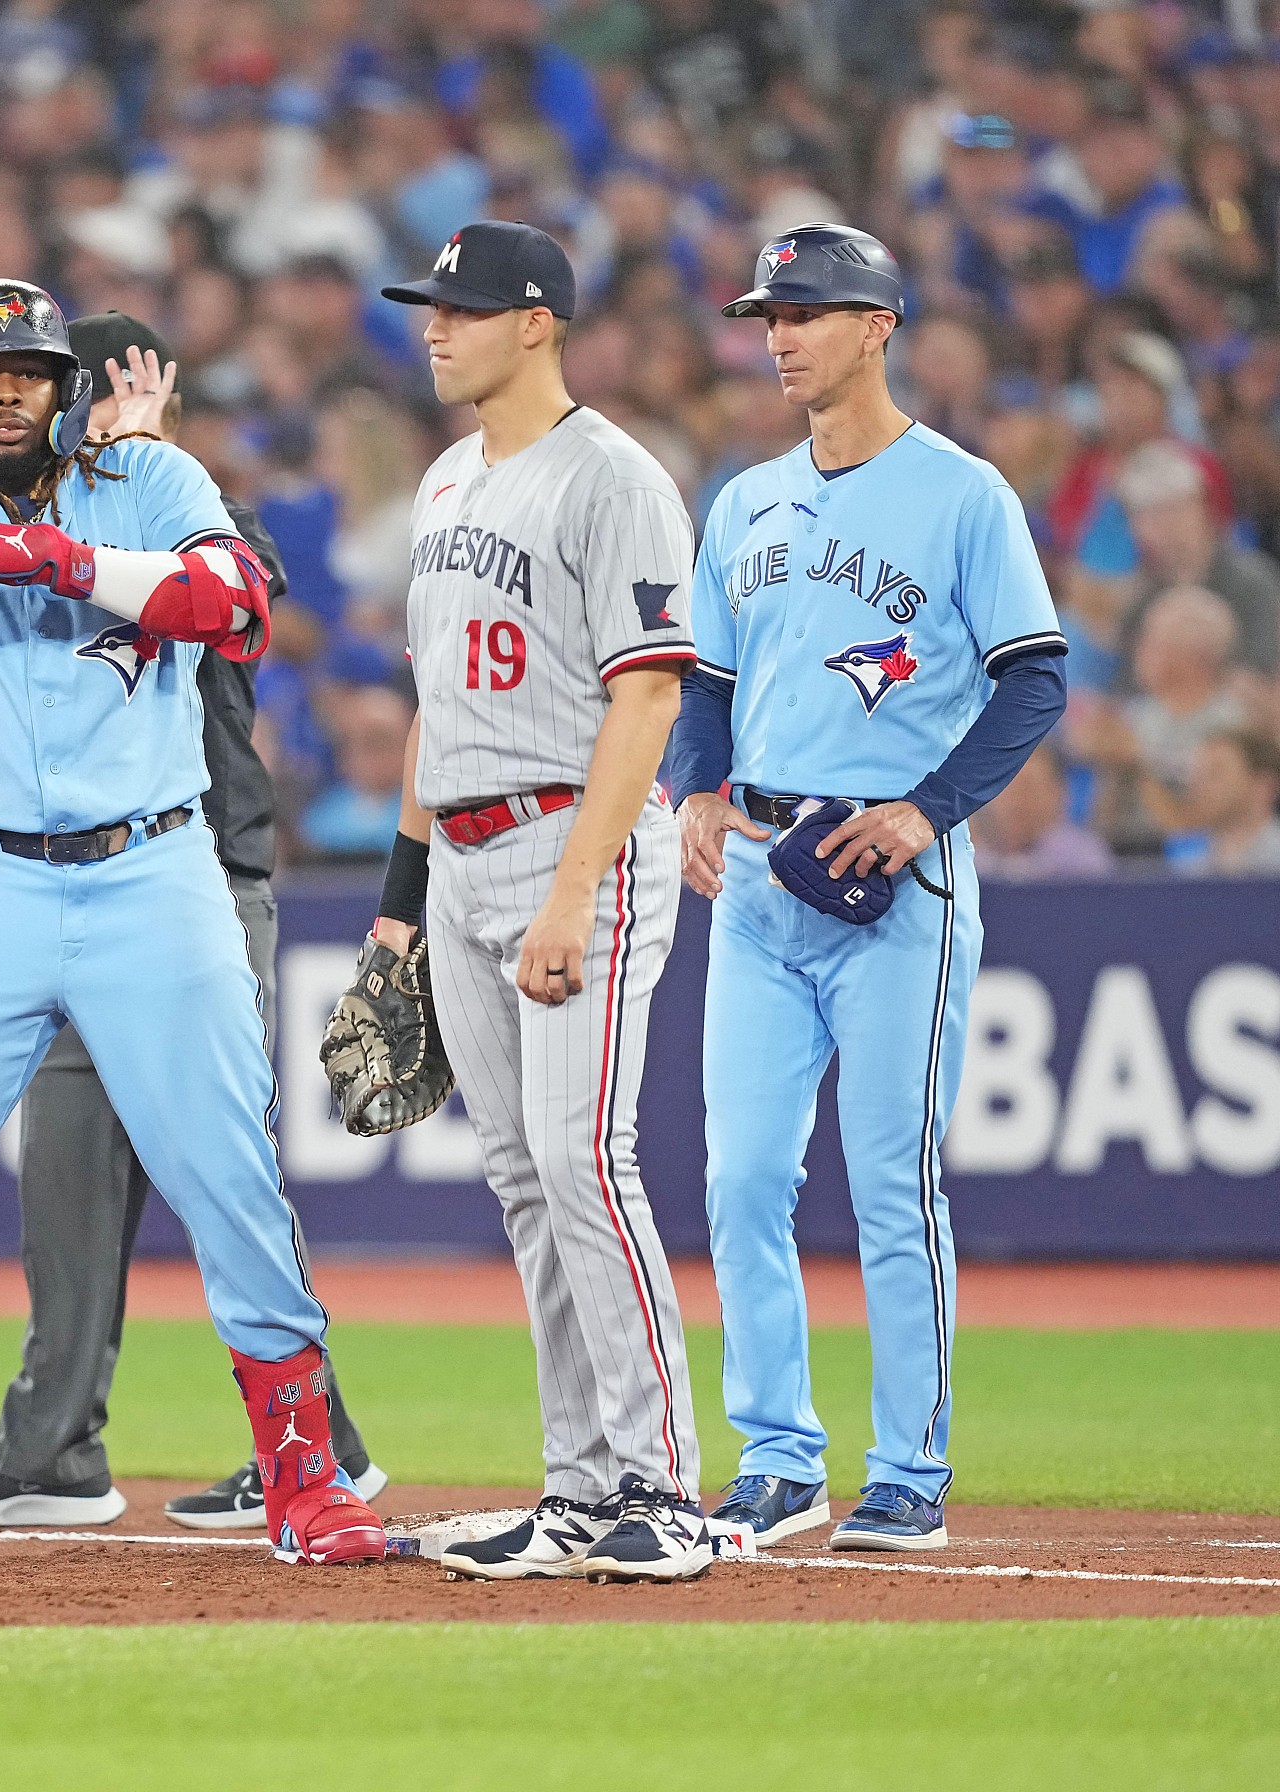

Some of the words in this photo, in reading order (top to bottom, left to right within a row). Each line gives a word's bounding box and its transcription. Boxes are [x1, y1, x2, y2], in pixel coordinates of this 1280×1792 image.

[433, 242, 462, 274] M
[411, 525, 533, 609] NNESOTA
[728, 542, 789, 624] LUE
[806, 538, 928, 624] JAYS
[465, 619, 527, 691] 19
[940, 962, 1280, 1177] BAS
